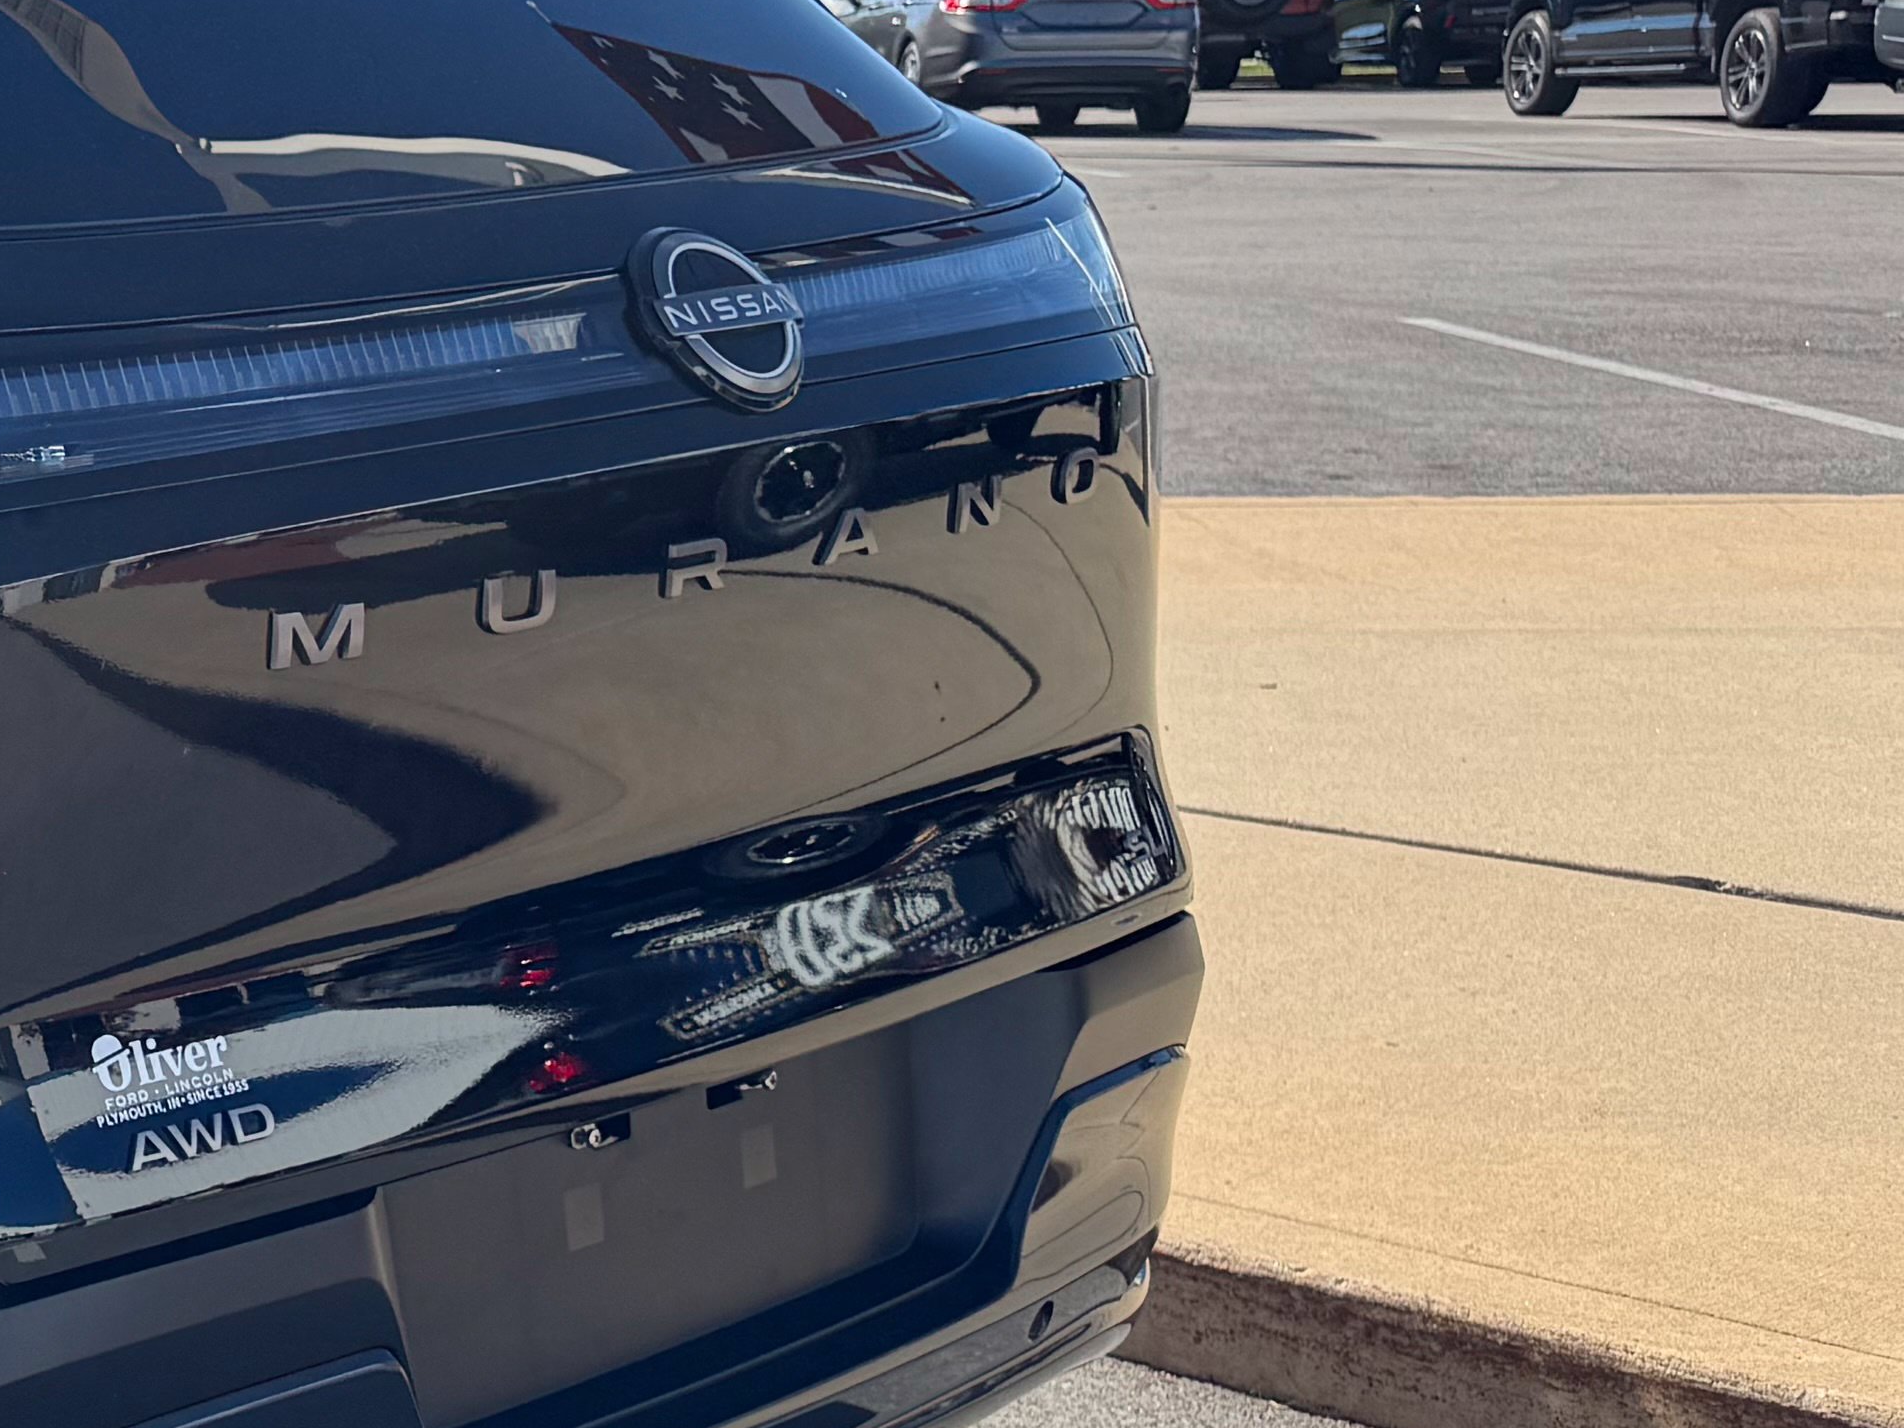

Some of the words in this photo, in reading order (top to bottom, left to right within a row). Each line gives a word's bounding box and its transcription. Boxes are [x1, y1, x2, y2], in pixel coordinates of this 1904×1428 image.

[664, 289, 796, 328] NISSAN
[267, 445, 1100, 671] MURANO
[92, 1034, 228, 1092] Oliver
[104, 1089, 149, 1111] FORD
[165, 1068, 234, 1095] LINCOLN
[96, 1102, 167, 1128] PLYMOUTH,
[223, 1079, 249, 1096] 1955
[132, 1103, 275, 1172] AWD
